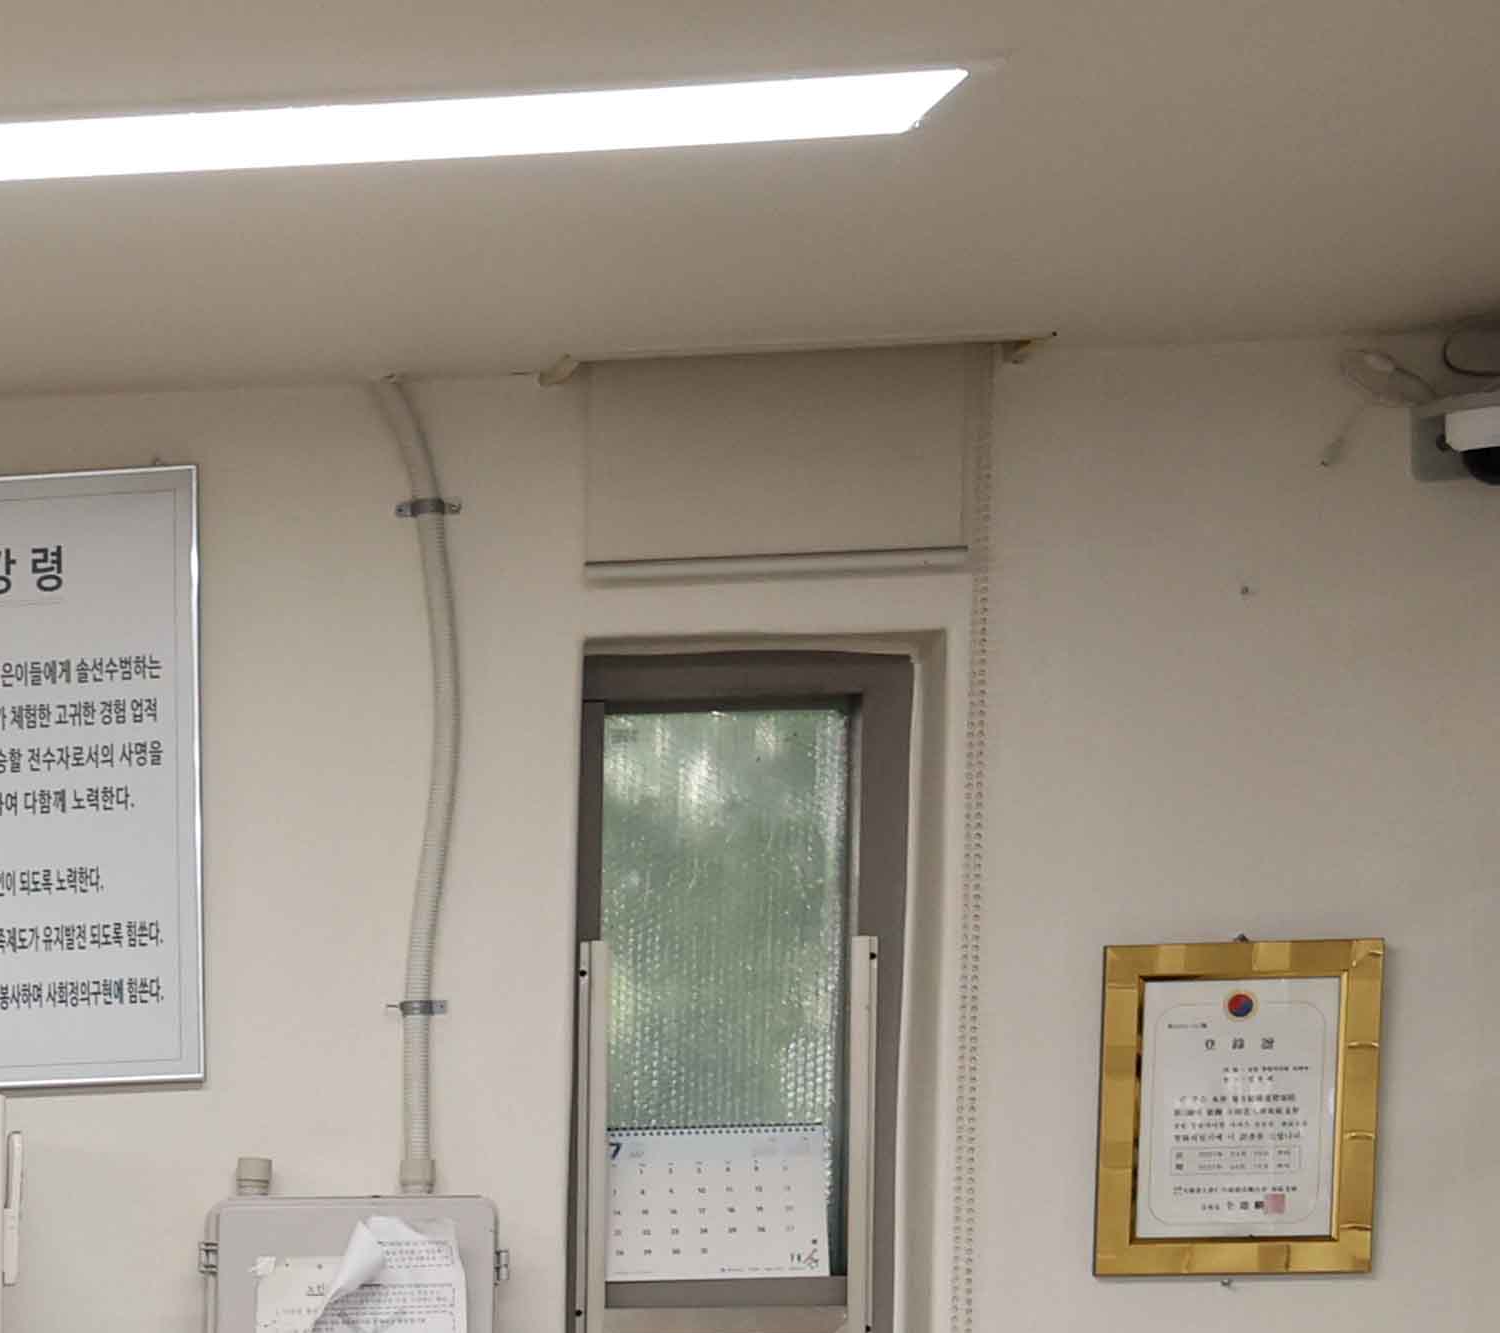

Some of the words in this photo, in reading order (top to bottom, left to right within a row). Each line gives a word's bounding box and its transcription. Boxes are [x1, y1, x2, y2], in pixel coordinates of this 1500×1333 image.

[75, 655, 162, 684] 솔선수범하는
[10, 704, 52, 731] 체험한
[54, 701, 96, 727] 고귀한
[99, 700, 127, 725] 경험
[130, 698, 158, 723] 업적
[27, 743, 115, 773] 전수자로서의
[119, 740, 163, 767] 사명을
[23, 789, 67, 815] 다함께
[71, 786, 135, 813] 노력한다.
[609, 1143, 622, 1159] 7
